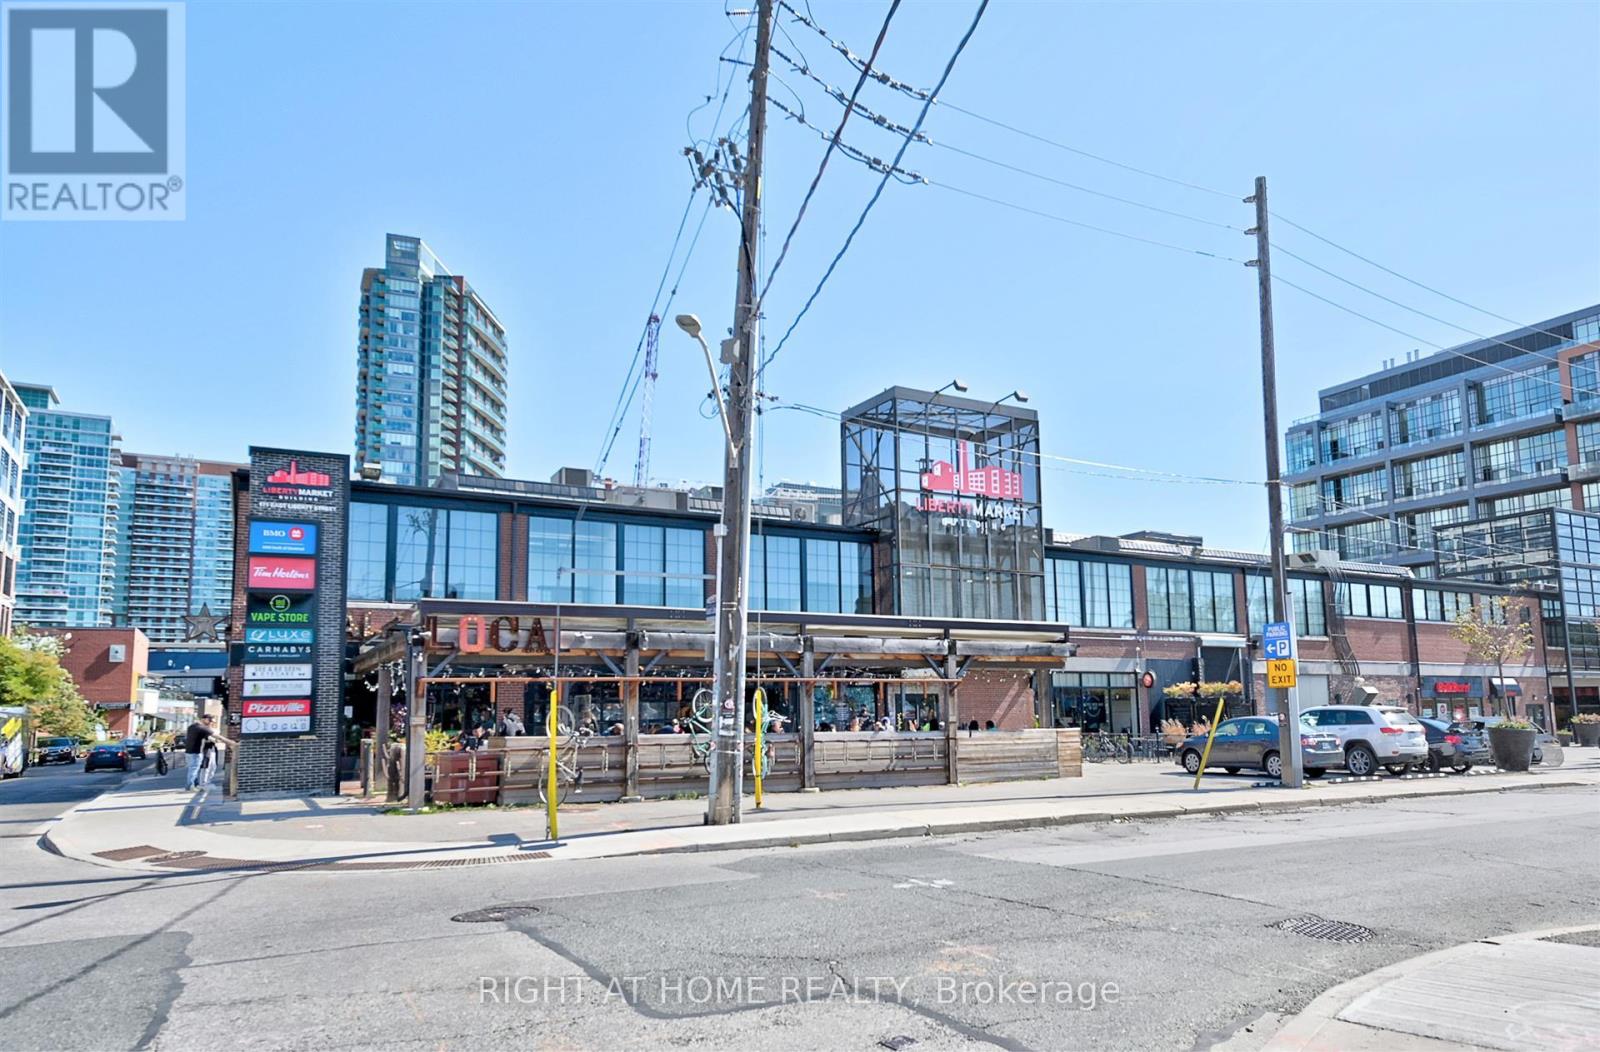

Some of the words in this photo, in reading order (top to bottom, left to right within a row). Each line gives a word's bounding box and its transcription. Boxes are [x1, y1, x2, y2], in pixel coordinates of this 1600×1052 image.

[263, 529, 286, 537] BMO
[253, 566, 272, 579] Tim
[273, 567, 310, 580] Hortons
[251, 612, 276, 622] VAPE
[278, 613, 309, 622] STORE
[1278, 641, 1287, 655] P
[1274, 663, 1288, 672] NO
[1272, 675, 1292, 684] EXIT
[247, 703, 306, 714] Pizzaville
